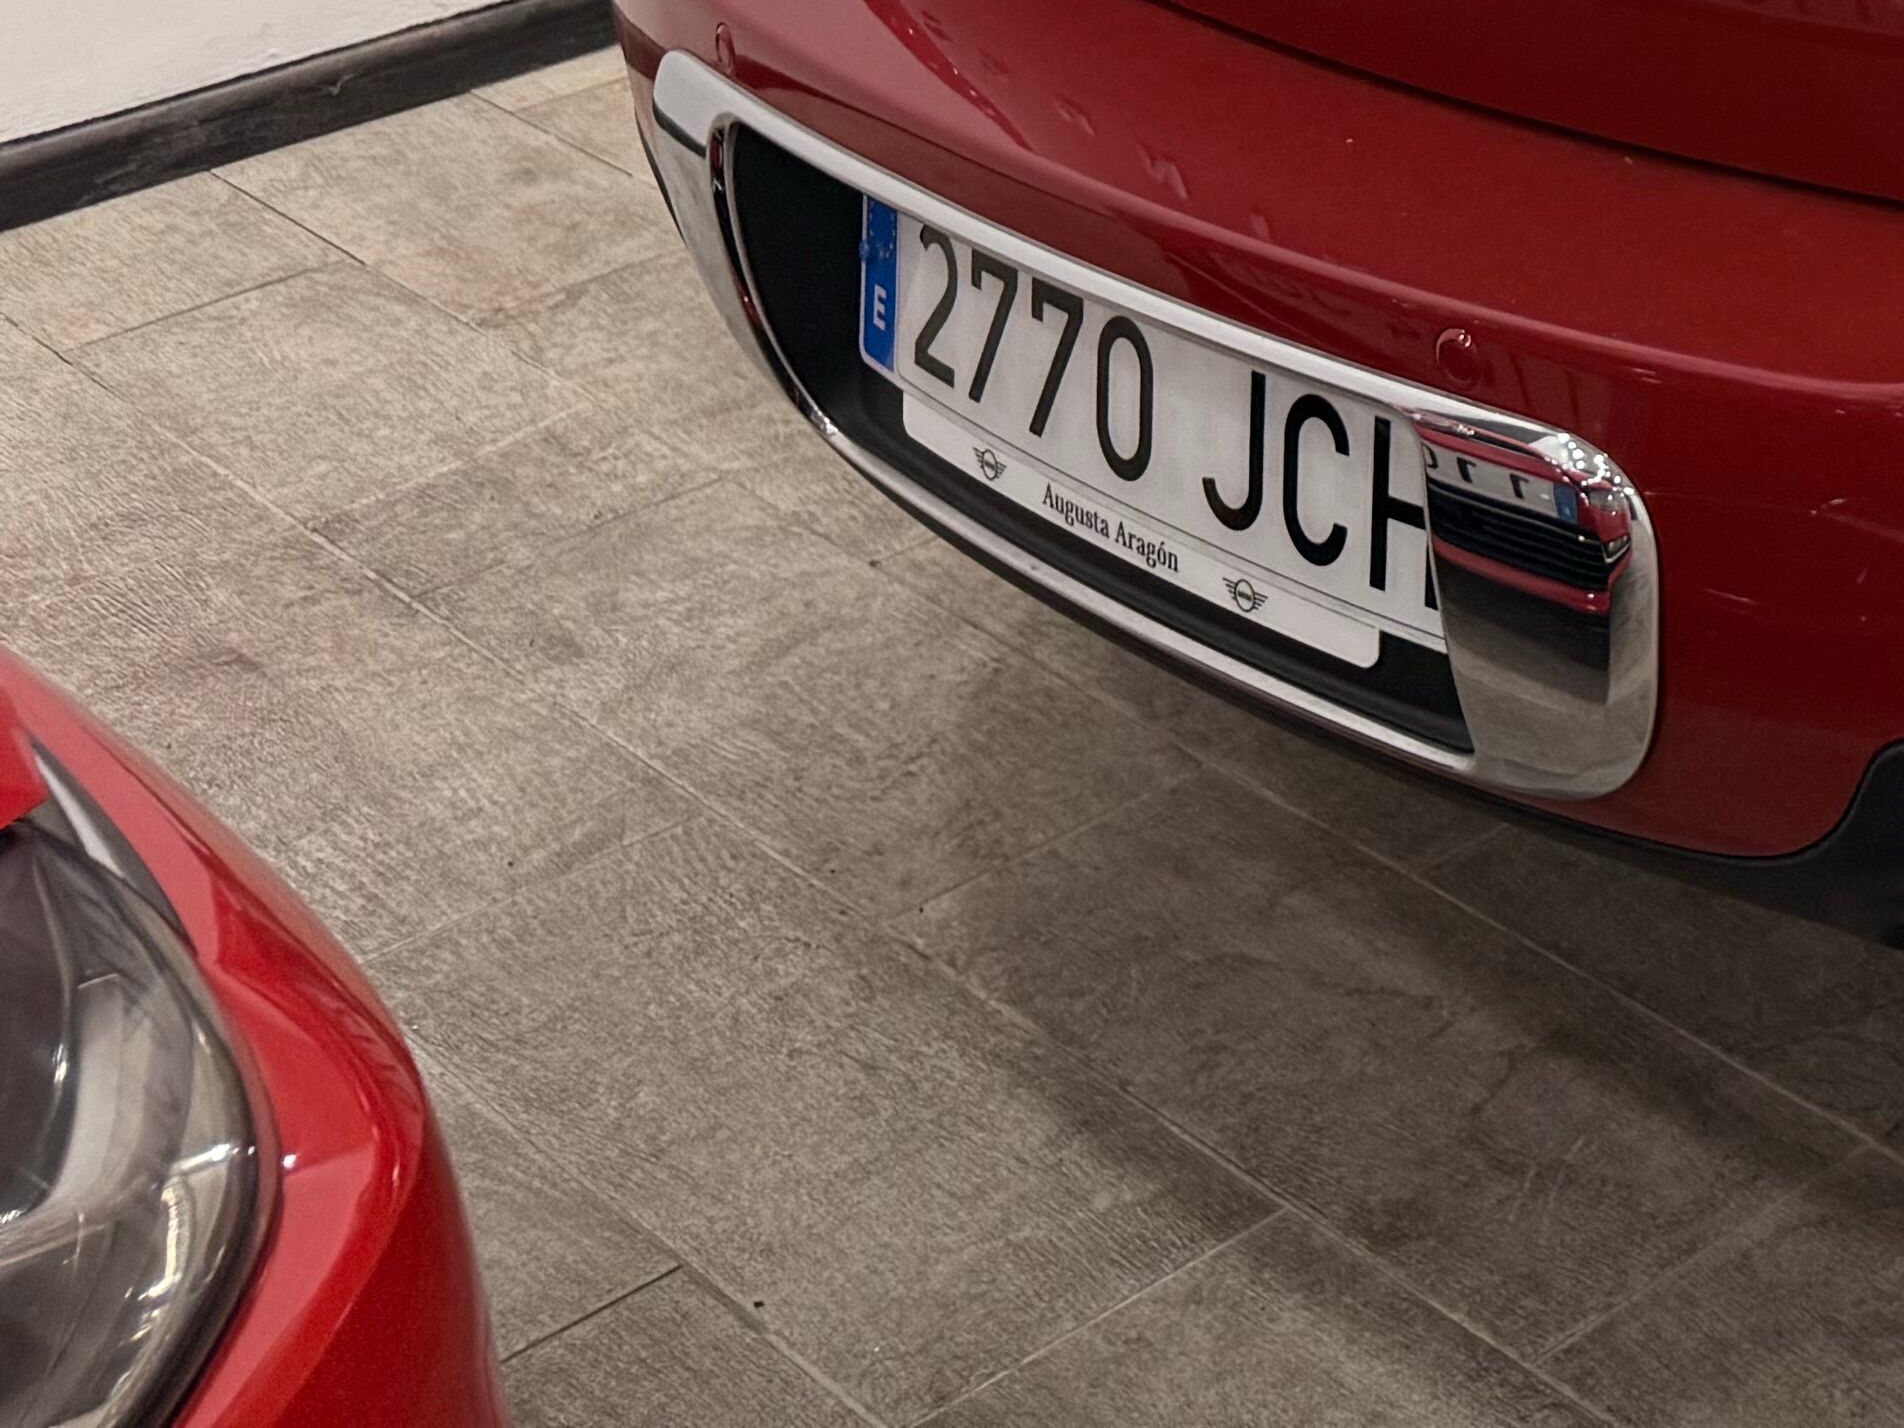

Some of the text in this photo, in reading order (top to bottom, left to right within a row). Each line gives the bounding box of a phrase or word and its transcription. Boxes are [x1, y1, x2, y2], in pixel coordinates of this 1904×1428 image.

[872, 282, 888, 332] E
[912, 223, 1153, 482] 2770
[1041, 481, 1180, 573] Augusta Aragón
